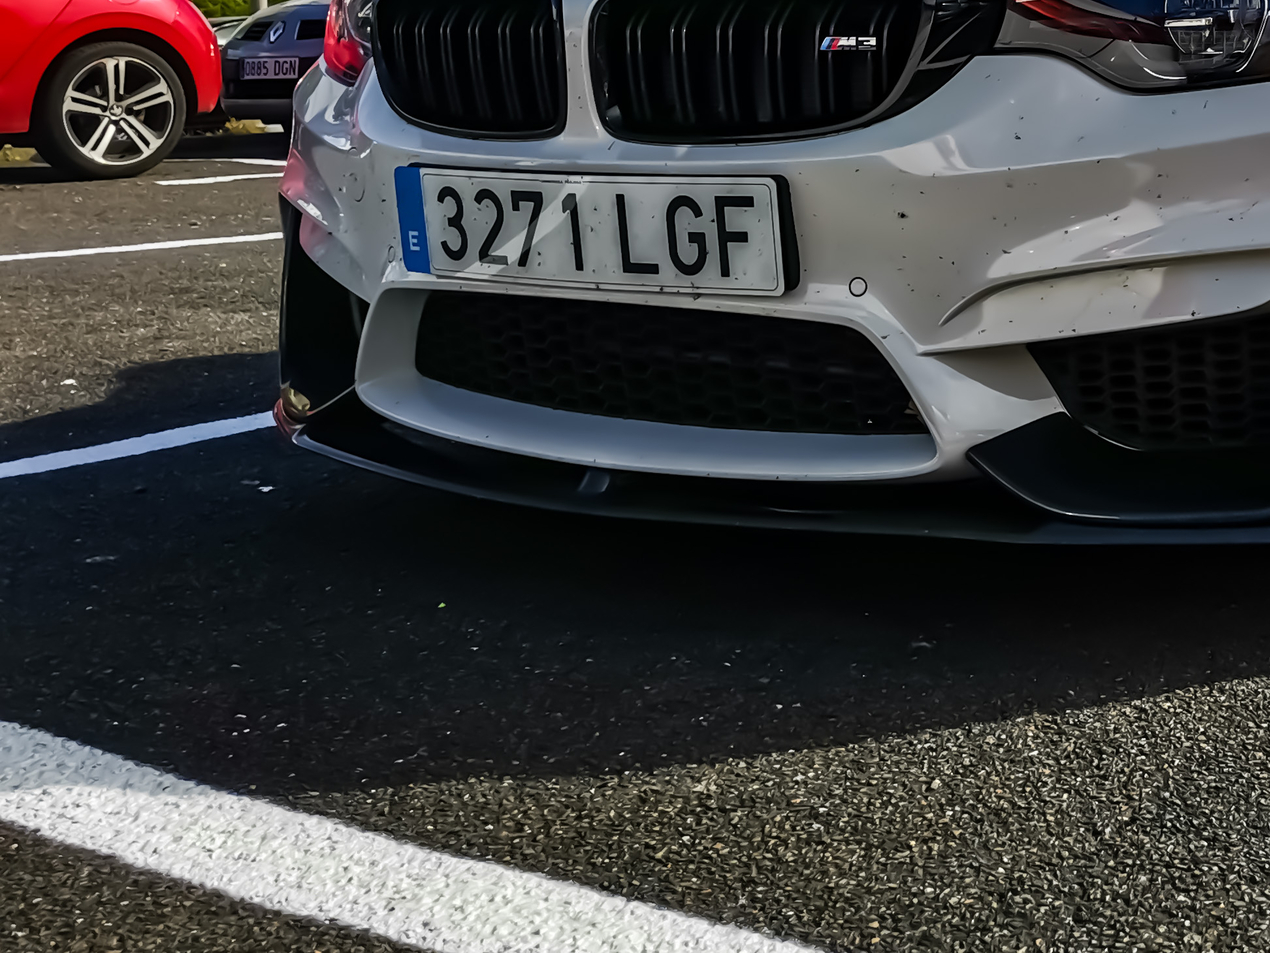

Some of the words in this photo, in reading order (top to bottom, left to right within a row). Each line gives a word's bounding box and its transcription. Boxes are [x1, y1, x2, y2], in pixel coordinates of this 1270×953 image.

[835, 36, 877, 51] M3
[245, 61, 269, 77] 0885
[274, 59, 297, 76] DGN
[408, 230, 421, 252] E
[436, 185, 585, 272] 3271
[615, 192, 755, 278] LGF
